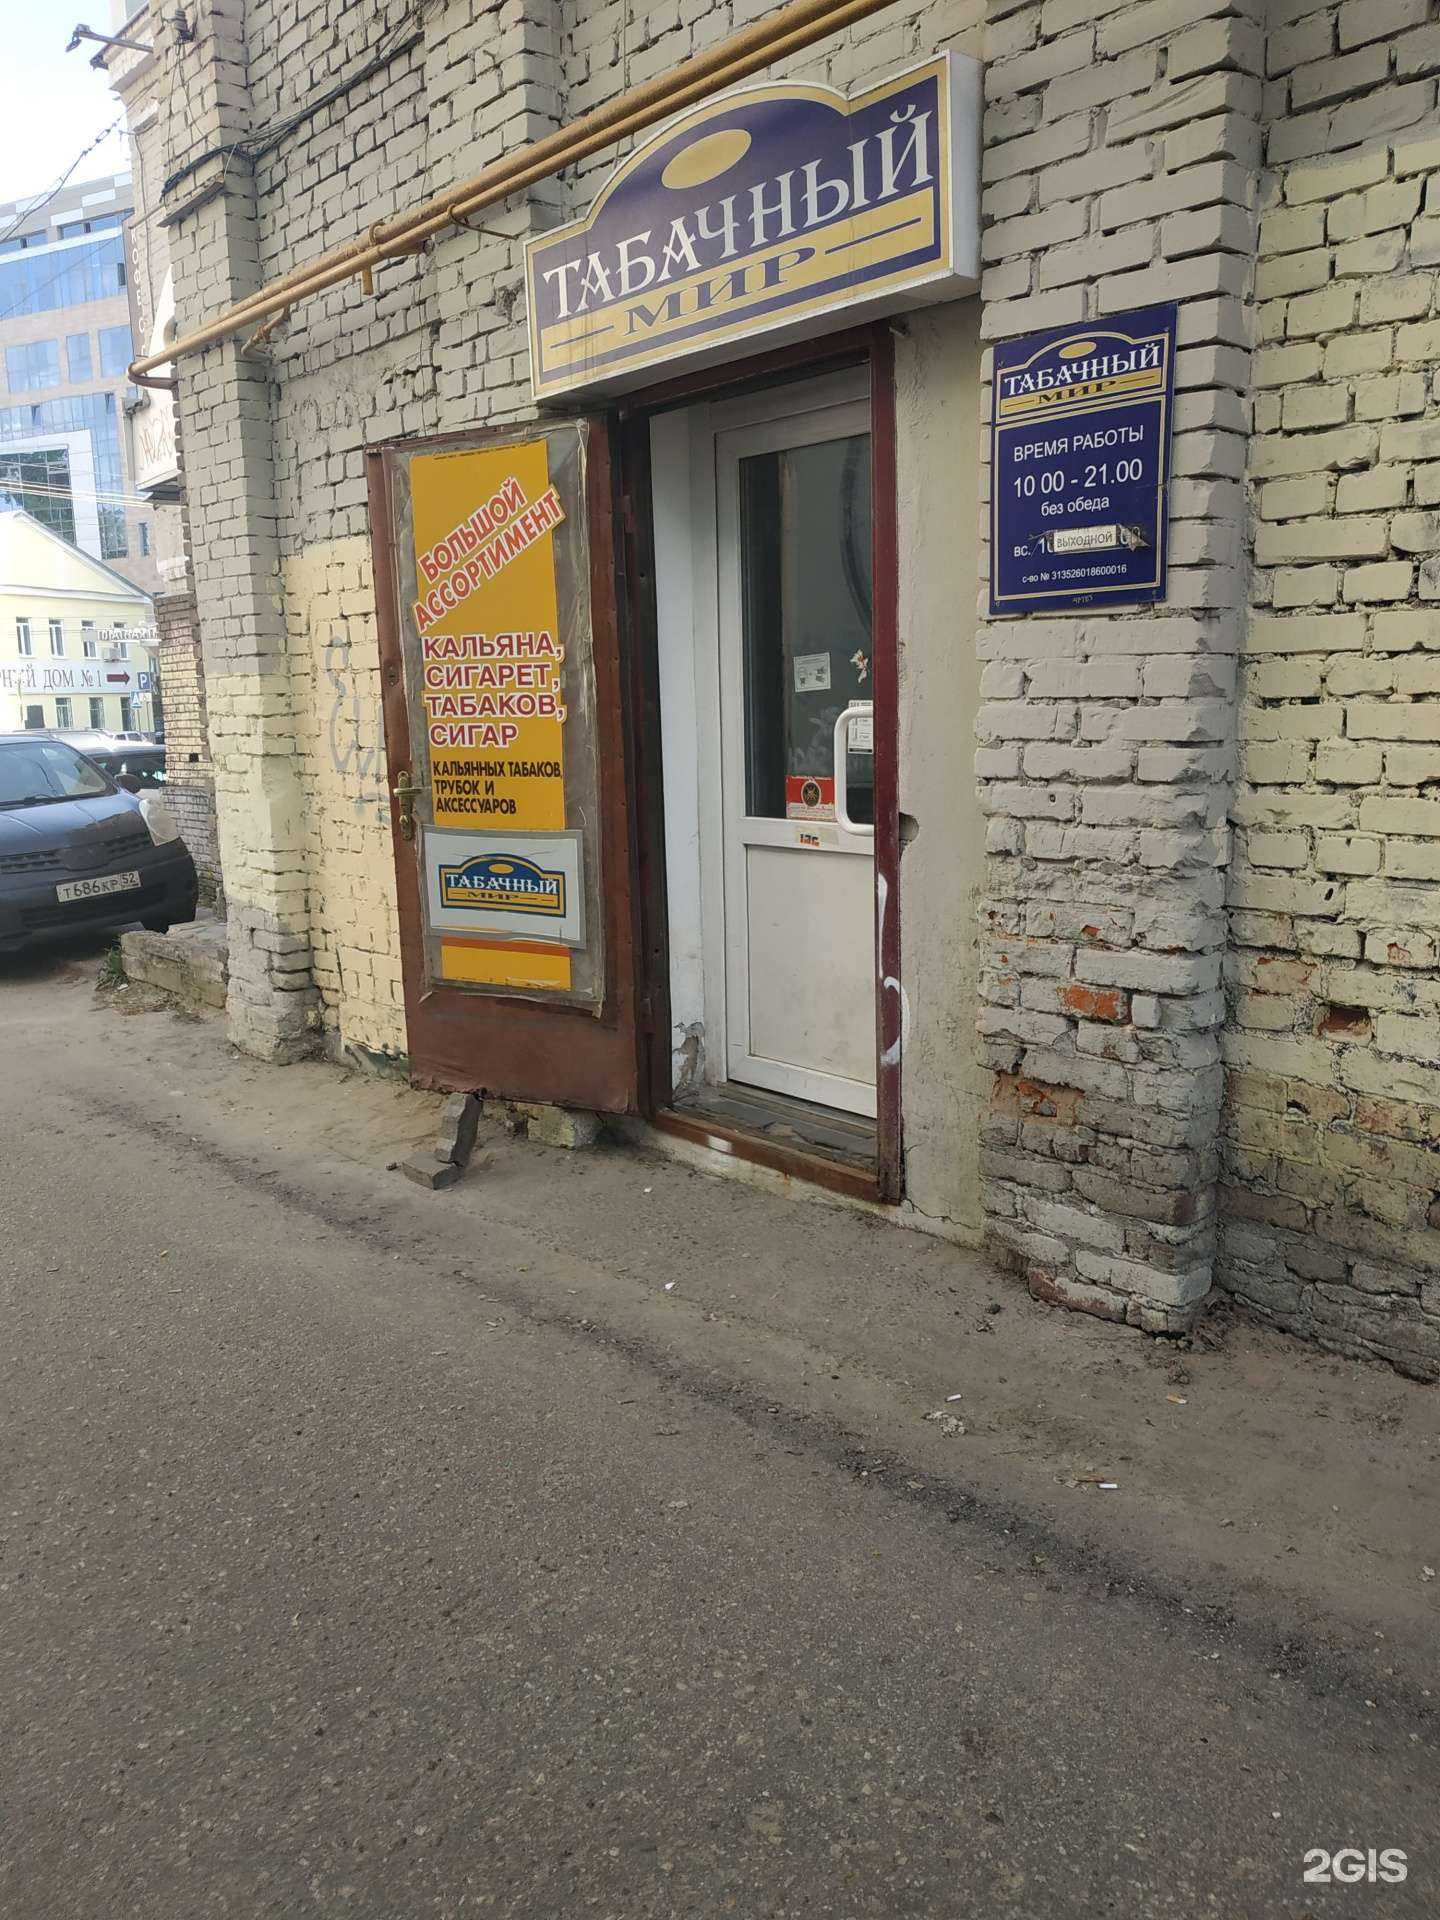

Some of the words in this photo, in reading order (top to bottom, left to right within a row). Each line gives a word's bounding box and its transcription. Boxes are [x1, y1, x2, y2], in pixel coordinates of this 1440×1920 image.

[543, 104, 935, 320] ТАБАЧНЫЙ
[624, 247, 817, 336] МИР
[1004, 342, 1161, 397] ТАБАЧНЫЙ
[1038, 380, 1117, 405] МИР
[1013, 437, 1069, 462] ВРЕМЯ
[1073, 424, 1144, 452] РАБОТЫ
[1083, 457, 1144, 488] 21.00
[1040, 500, 1064, 517] без
[1067, 495, 1110, 513] обеда
[418, 477, 527, 583] БОЛЬШОЙ
[1056, 531, 1113, 549] ВЫХОДНОЙ
[413, 489, 563, 633] АССОРТИМЕНТ
[423, 632, 563, 661] КАЛЬЯНА,
[43, 669, 75, 690] ДОМ
[80, 669, 95, 687] №
[425, 663, 560, 690] СИГАРЕТ,
[425, 693, 565, 719] ТАБАКОВ,
[429, 723, 519, 747] СИГАР
[433, 760, 506, 777] КАЛЬЯННЫХ
[507, 761, 563, 779] ТАБАКОВ,
[434, 779, 480, 796] ТРУБОК
[484, 780, 495, 796] И
[435, 797, 517, 815] АКСЕССУАРОВ
[121, 872, 136, 885] 52
[446, 873, 559, 895] ТАБАЧНЫЙ
[467, 890, 520, 901] МИР
